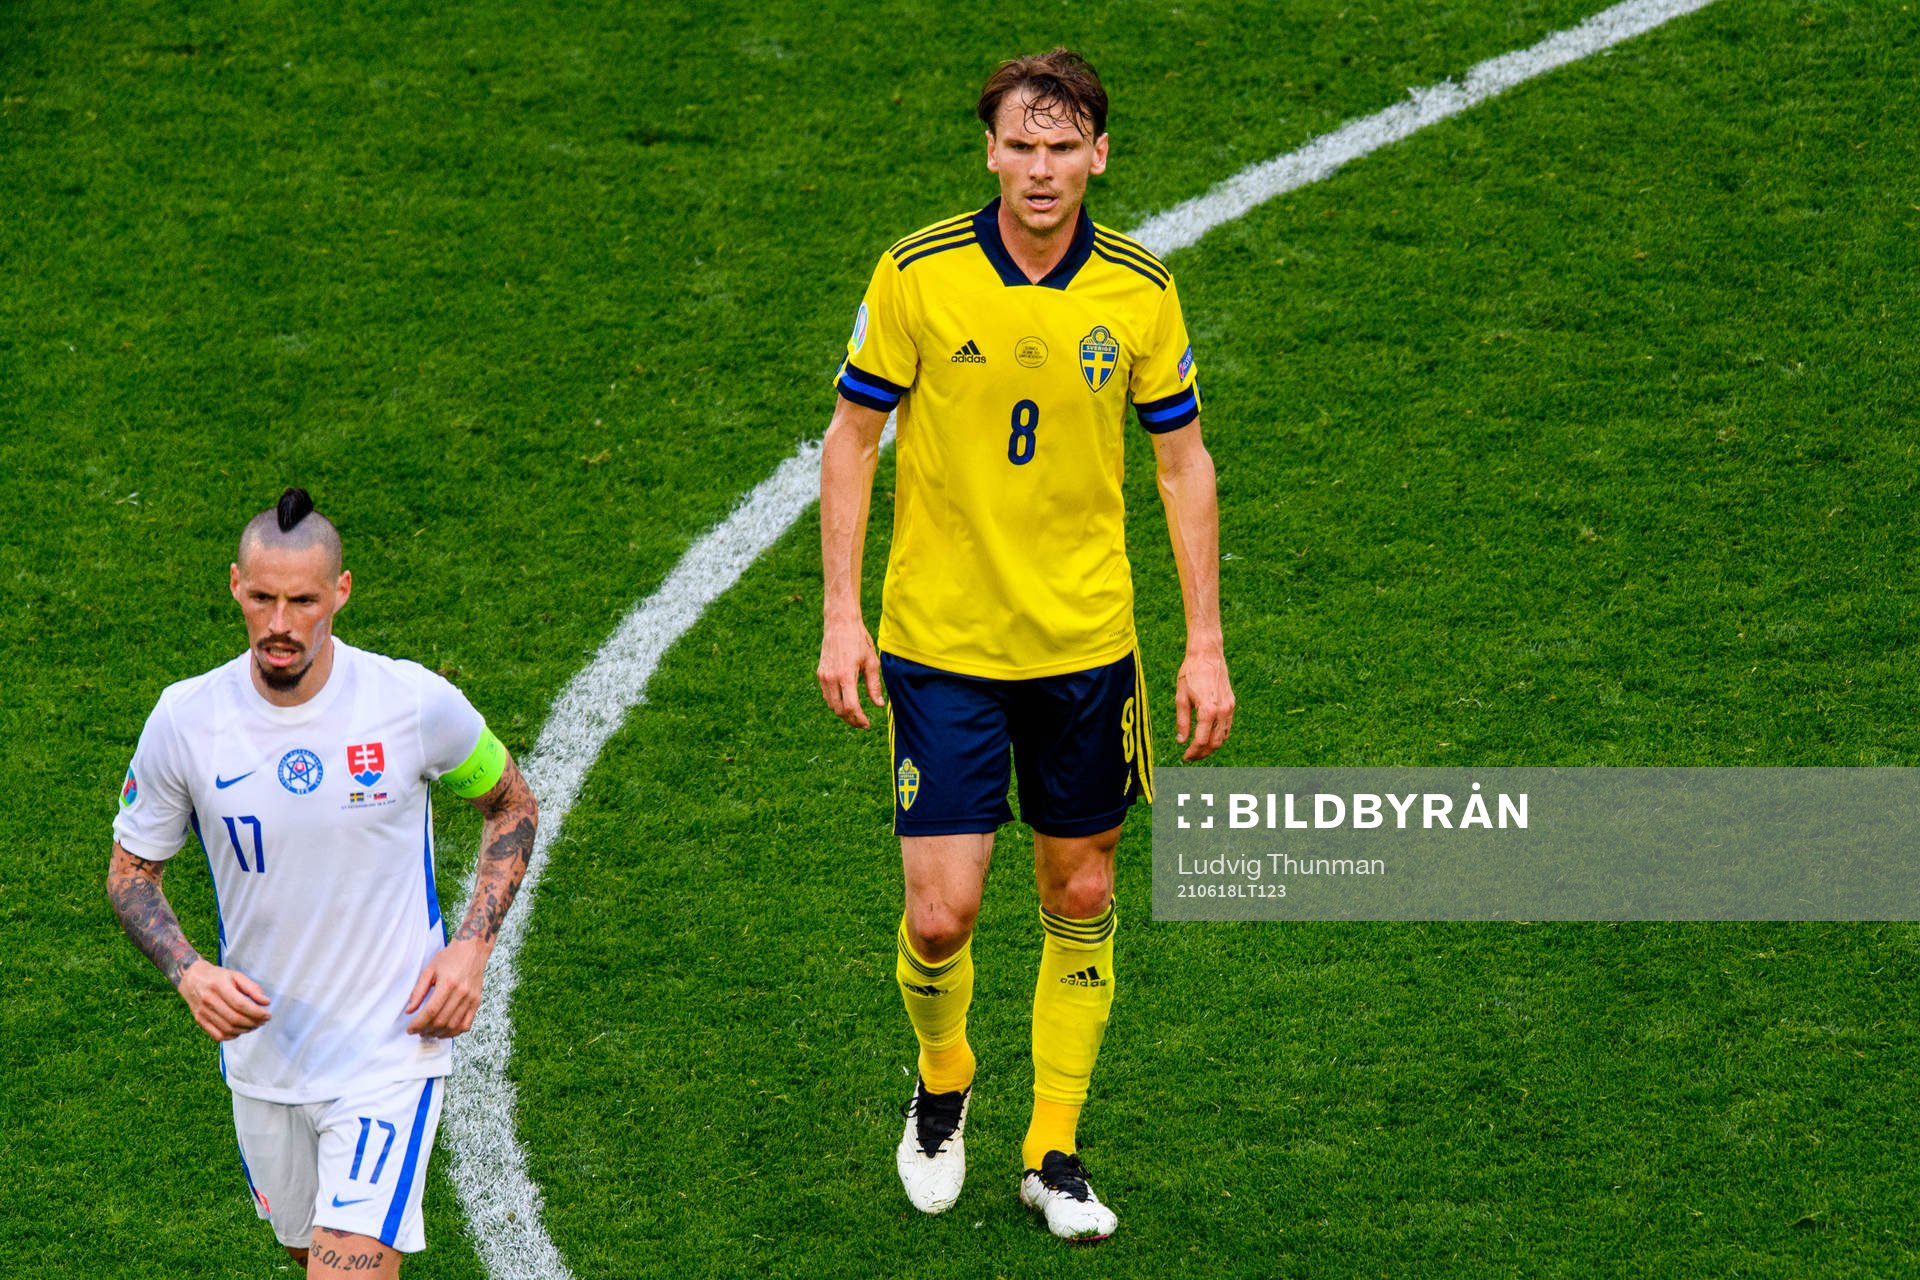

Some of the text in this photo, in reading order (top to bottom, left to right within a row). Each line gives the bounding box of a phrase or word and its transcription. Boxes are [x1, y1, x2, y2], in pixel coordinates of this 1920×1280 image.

[951, 354, 987, 364] adidas
[1008, 399, 1039, 465] 8
[1121, 697, 1134, 763] 8
[222, 815, 265, 873] 17
[1060, 977, 1107, 988] adidas
[349, 1117, 396, 1184] 17
